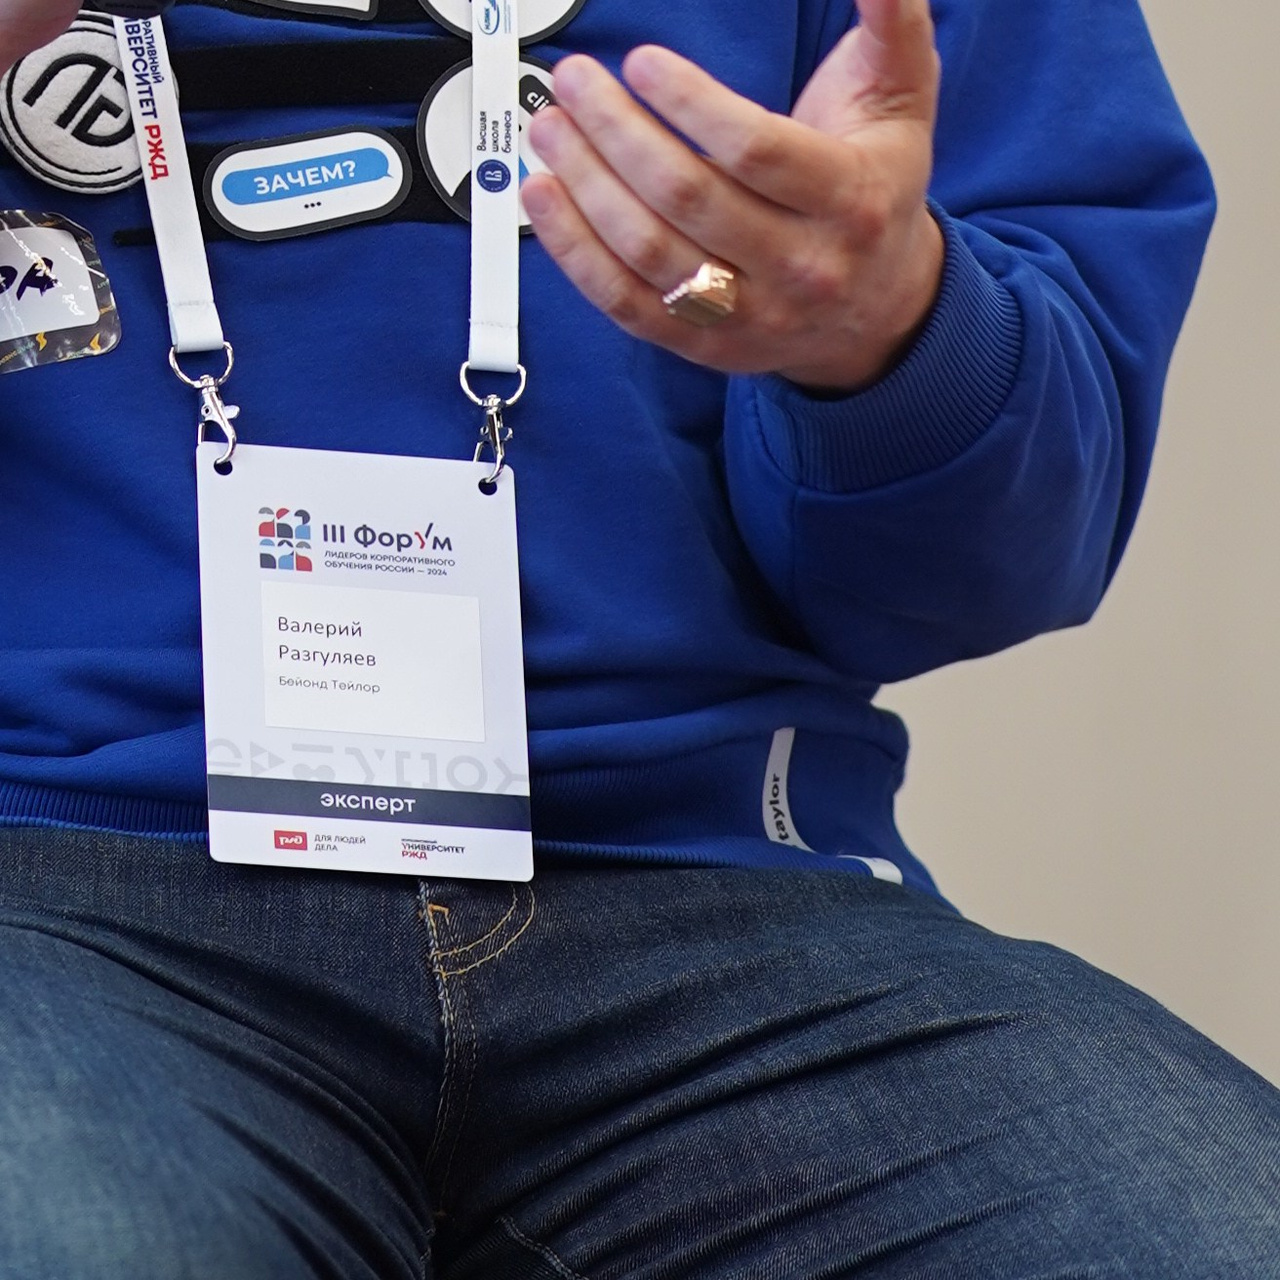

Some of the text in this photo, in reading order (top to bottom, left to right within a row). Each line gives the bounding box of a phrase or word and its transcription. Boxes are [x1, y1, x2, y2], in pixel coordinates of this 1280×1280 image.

[141, 18, 165, 84] РАТИВНЫЙ
[476, 110, 488, 152] Высшая
[492, 120, 500, 153] школа
[501, 110, 512, 153] бизнеса
[144, 124, 169, 181] РЖД
[253, 159, 357, 195] ЗАЧЕМ?
[322, 523, 345, 543] III
[324, 550, 456, 567] ЛИДЕРОВ КОРПОРАТИВНОГО
[324, 560, 373, 570] ОБУЧЕНИЯ
[375, 564, 415, 574] РОССИИ
[427, 568, 448, 576] 2024
[278, 616, 362, 638] Валерий
[278, 644, 376, 667] Разгуляев
[278, 675, 381, 694] Бейонд Тейлор
[320, 792, 417, 815] эксперт
[768, 773, 789, 841] taylor
[314, 834, 367, 845] ДЛЯ ЛЮДЕЙ
[314, 843, 338, 852] ДЕЛА
[401, 842, 466, 854] УНИВЕРСИТЕТ
[401, 850, 428, 860] РЖД
